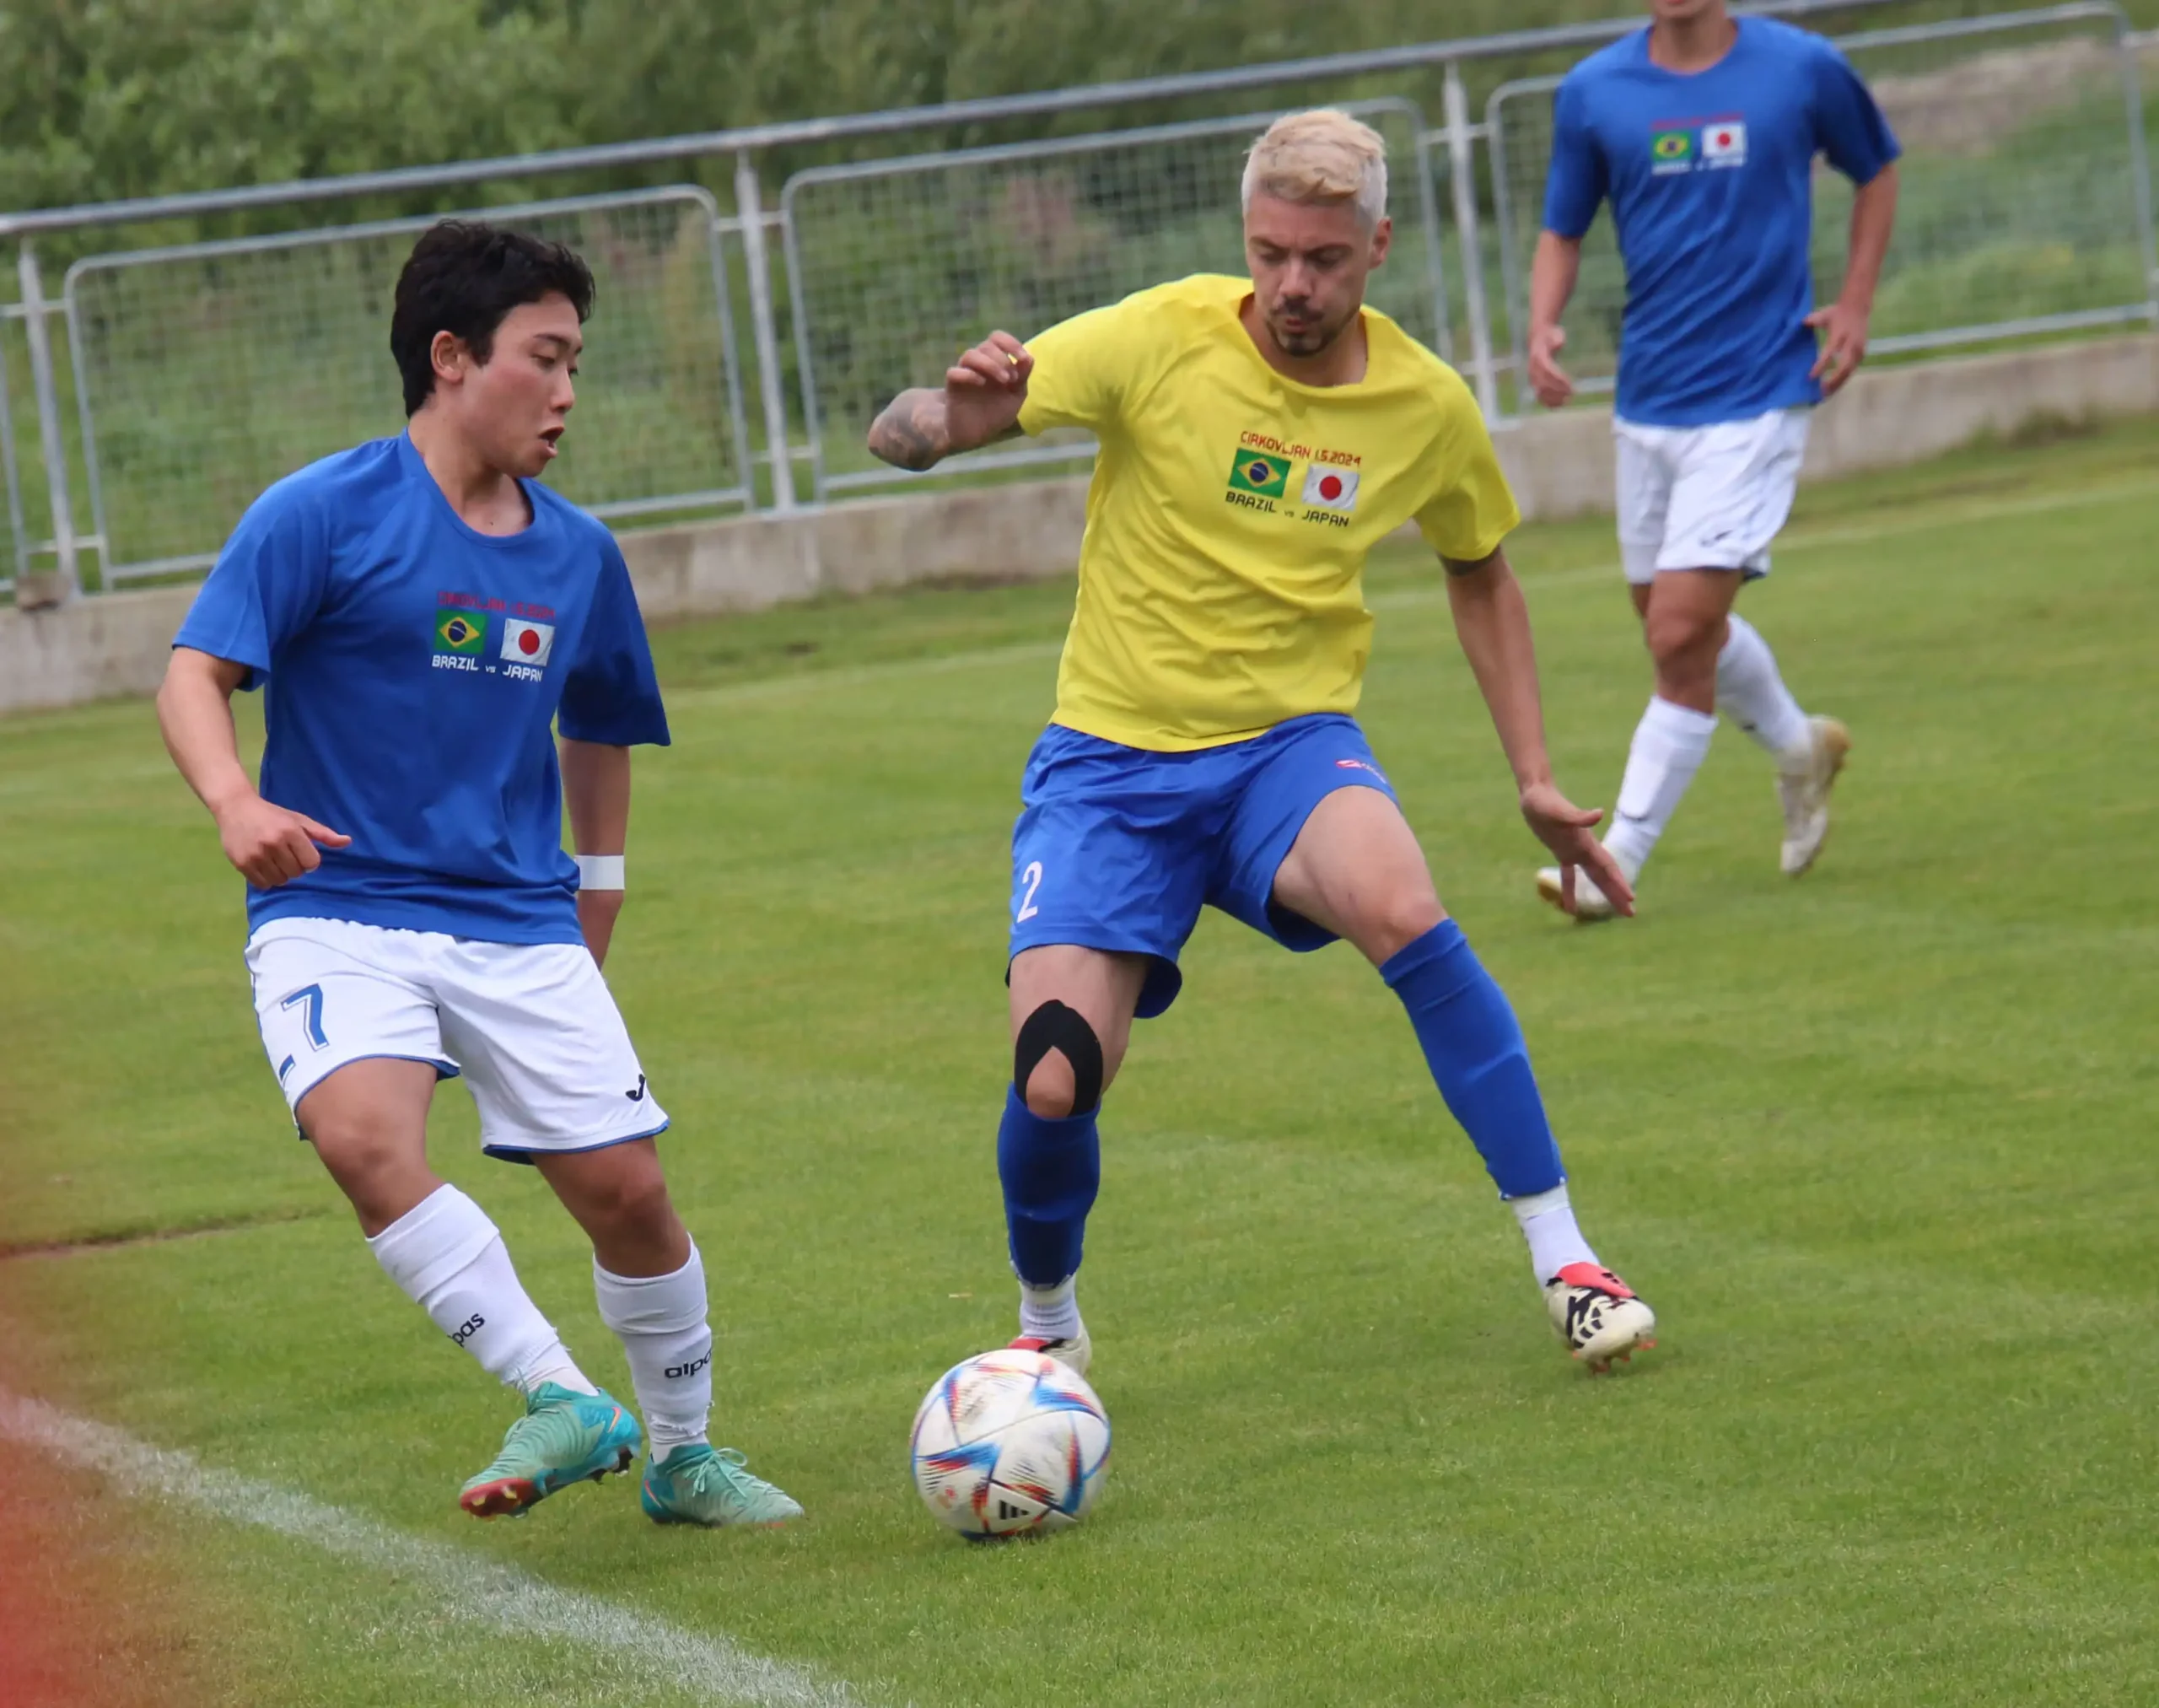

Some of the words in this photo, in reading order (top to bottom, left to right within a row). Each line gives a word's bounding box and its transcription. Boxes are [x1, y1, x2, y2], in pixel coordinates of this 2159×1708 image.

[1240, 430, 1311, 460] CIRKOVLJAN
[1225, 490, 1277, 514] BRAZIL
[1301, 509, 1350, 528] JAPAN
[432, 654, 479, 671] BRAZIL
[502, 664, 543, 682] JAPAN
[1016, 860, 1042, 924] 2
[279, 982, 330, 1081] 7
[446, 1312, 486, 1349] pas
